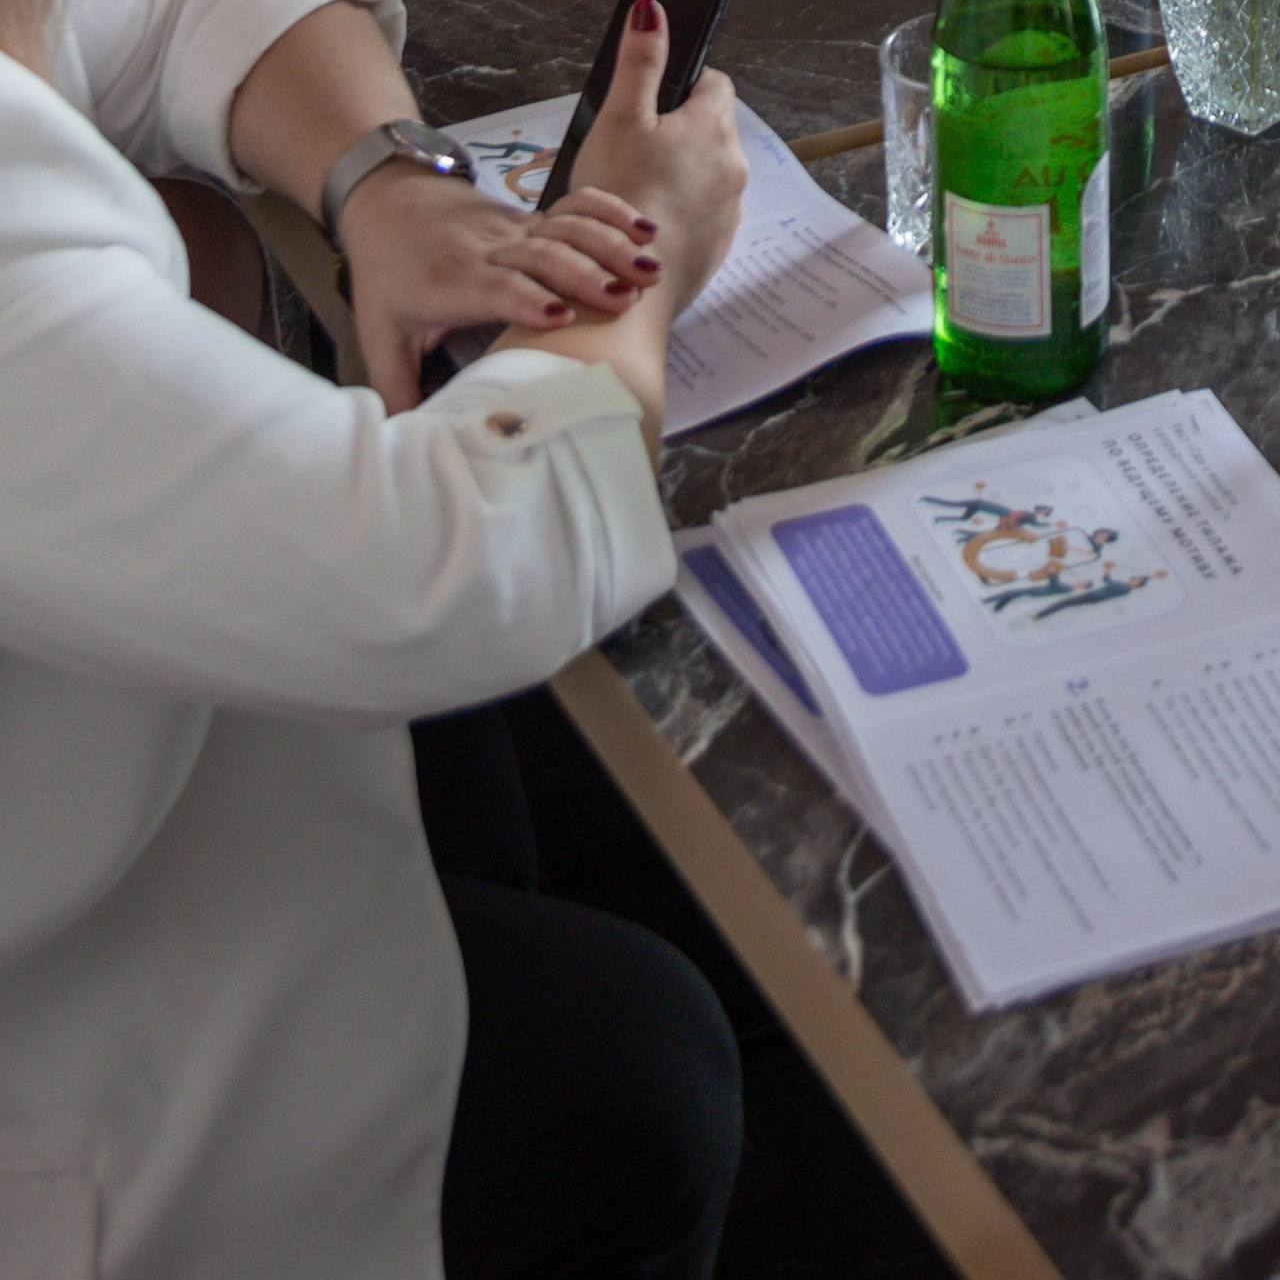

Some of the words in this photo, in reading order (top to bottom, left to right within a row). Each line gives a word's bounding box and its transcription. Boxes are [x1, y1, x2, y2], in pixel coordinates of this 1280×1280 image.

[1101, 439, 1124, 456] ПО
[1115, 459, 1174, 524] ВЕДУЩЕМУ
[1169, 527, 1218, 580] МОТИВУ
[1126, 433, 1202, 518] ОПРЕДЕЛЕНИЕ
[1193, 520, 1246, 574] ТИПАЖА
